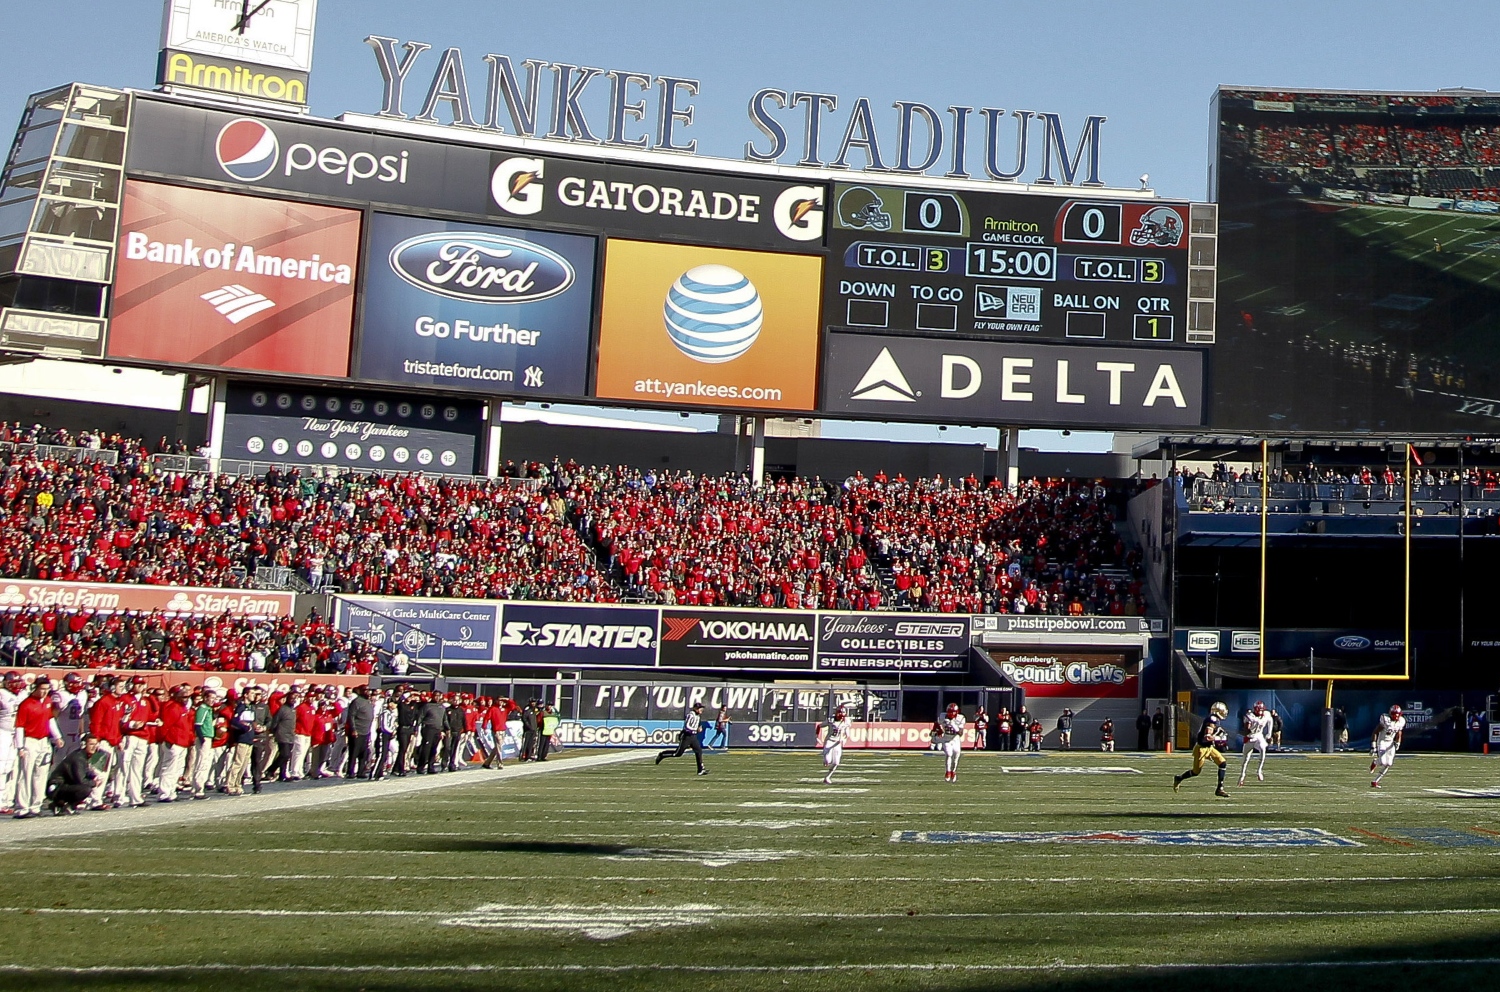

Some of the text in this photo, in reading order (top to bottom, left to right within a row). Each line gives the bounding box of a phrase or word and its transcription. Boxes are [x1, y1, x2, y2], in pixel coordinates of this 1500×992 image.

[195, 30, 287, 53] AMERICA'S WATCH
[169, 54, 304, 103] Armitron
[363, 35, 700, 153] YANKEE
[744, 88, 1108, 186] STADIUM
[284, 143, 408, 185] pepsi
[491, 158, 824, 242] G GATORADE G
[919, 198, 942, 229] 0
[984, 216, 1038, 232] Armitron
[1083, 208, 1105, 238] 0
[982, 232, 1045, 245] GAME CLOCK
[127, 232, 351, 284] Bank of America
[427, 241, 539, 293] Ford
[864, 248, 943, 270] T.O.L. 3
[973, 248, 1051, 276] 15:00
[1080, 261, 1158, 281] T.O.L. 3
[840, 281, 964, 302] DOWN TO GO
[1012, 294, 1035, 304] NEW
[1054, 294, 1120, 309] BALL ON
[1012, 303, 1036, 314] ERA
[1137, 297, 1170, 313] QTR
[415, 316, 541, 346] Go Further
[974, 321, 1040, 332] FLY YOUR OWN FLAG
[1147, 318, 1157, 337] 1
[404, 359, 513, 382] tristateford.com
[940, 354, 1187, 407] DELTA
[634, 378, 782, 400] att.yankees.com
[302, 417, 409, 441] New York Yankees
[393, 609, 417, 618] Circle
[419, 610, 461, 620] MultiCare
[463, 612, 490, 621] Center
[1008, 617, 1126, 631] pinstripebowl.com
[538, 623, 652, 648] STARTER
[822, 616, 963, 641] Yankees STEINER
[841, 639, 944, 651] COLLECTIBLES
[1191, 637, 1217, 645] HESS
[1235, 637, 1260, 645] HESS
[1340, 638, 1364, 648] Ford
[725, 650, 808, 661] yokohamatire.com
[821, 658, 963, 669] STEINERSPORTS.COM
[1009, 656, 1057, 665] Goldenberg's
[1001, 662, 1127, 684] Peanut Chews
[849, 728, 905, 742] UNKIN'
